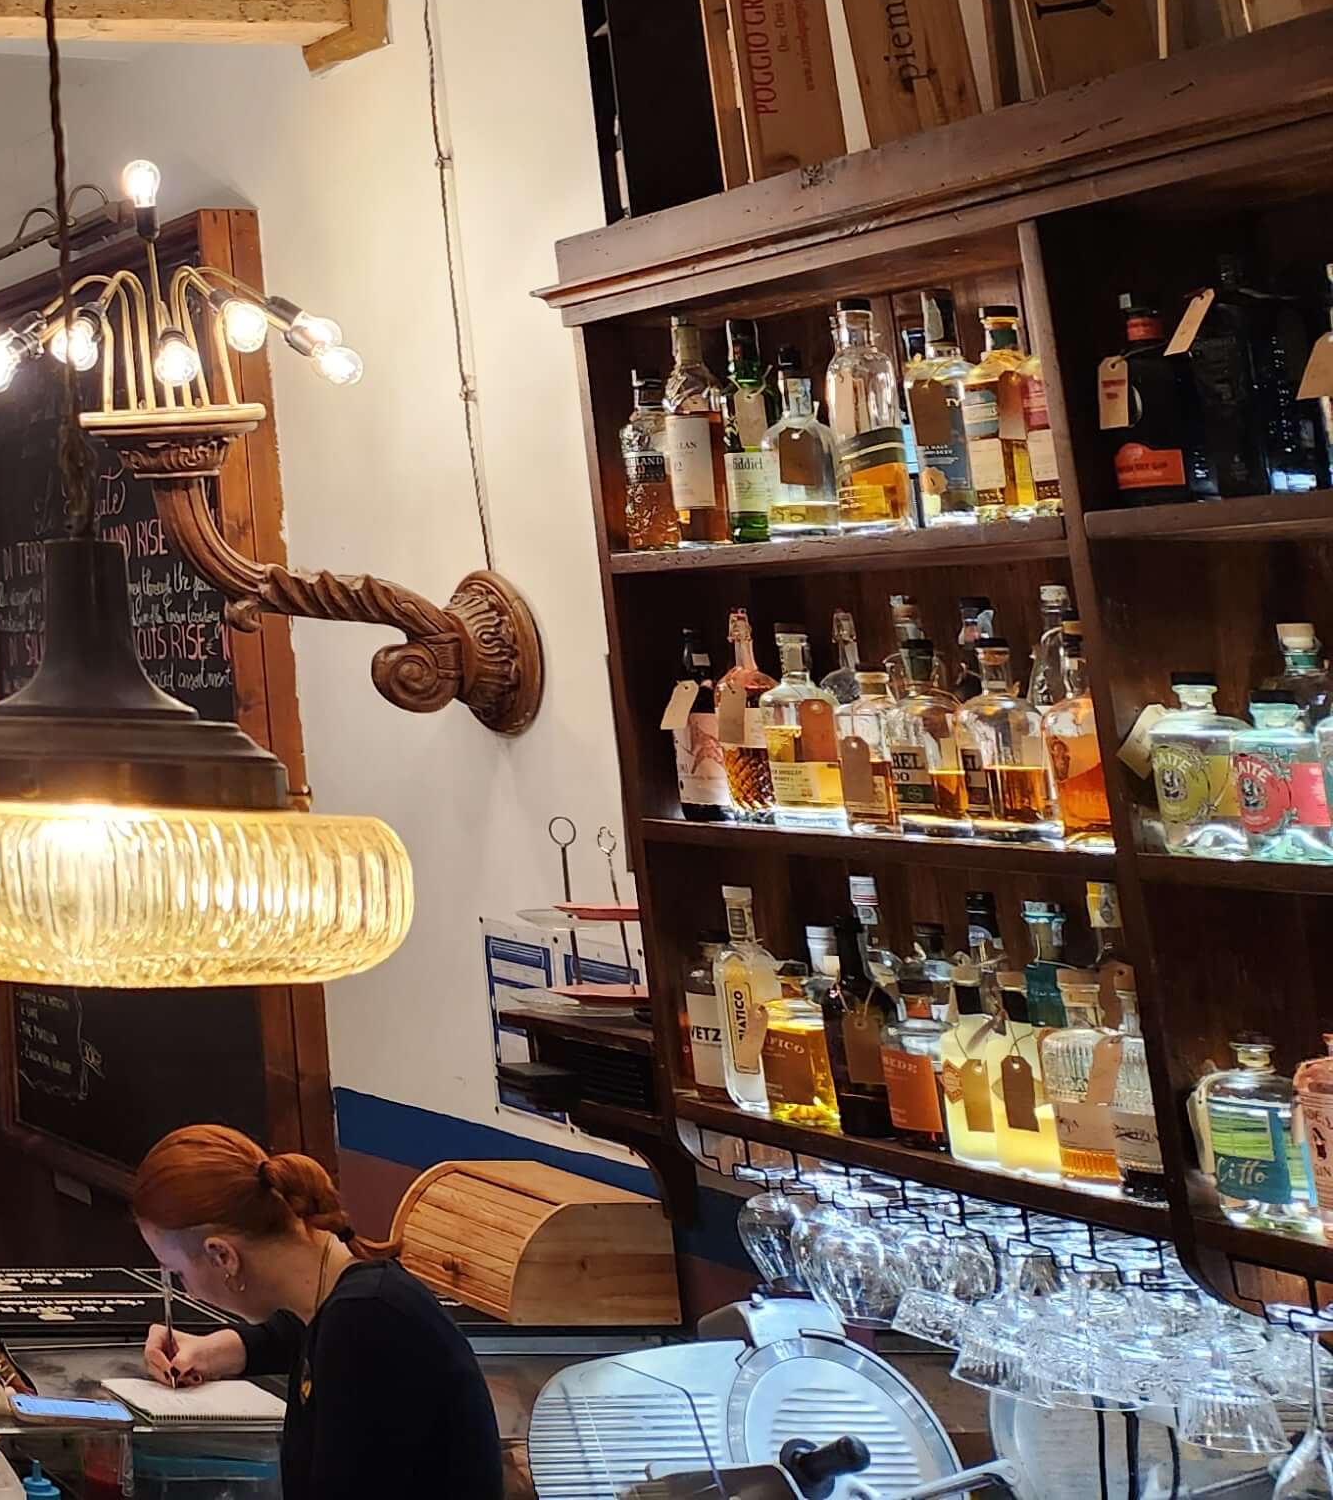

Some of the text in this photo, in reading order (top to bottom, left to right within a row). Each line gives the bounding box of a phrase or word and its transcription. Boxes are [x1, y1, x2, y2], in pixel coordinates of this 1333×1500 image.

[744, 28, 779, 115] POGGIO
[136, 518, 168, 558] RISE
[169, 623, 206, 662] RISE
